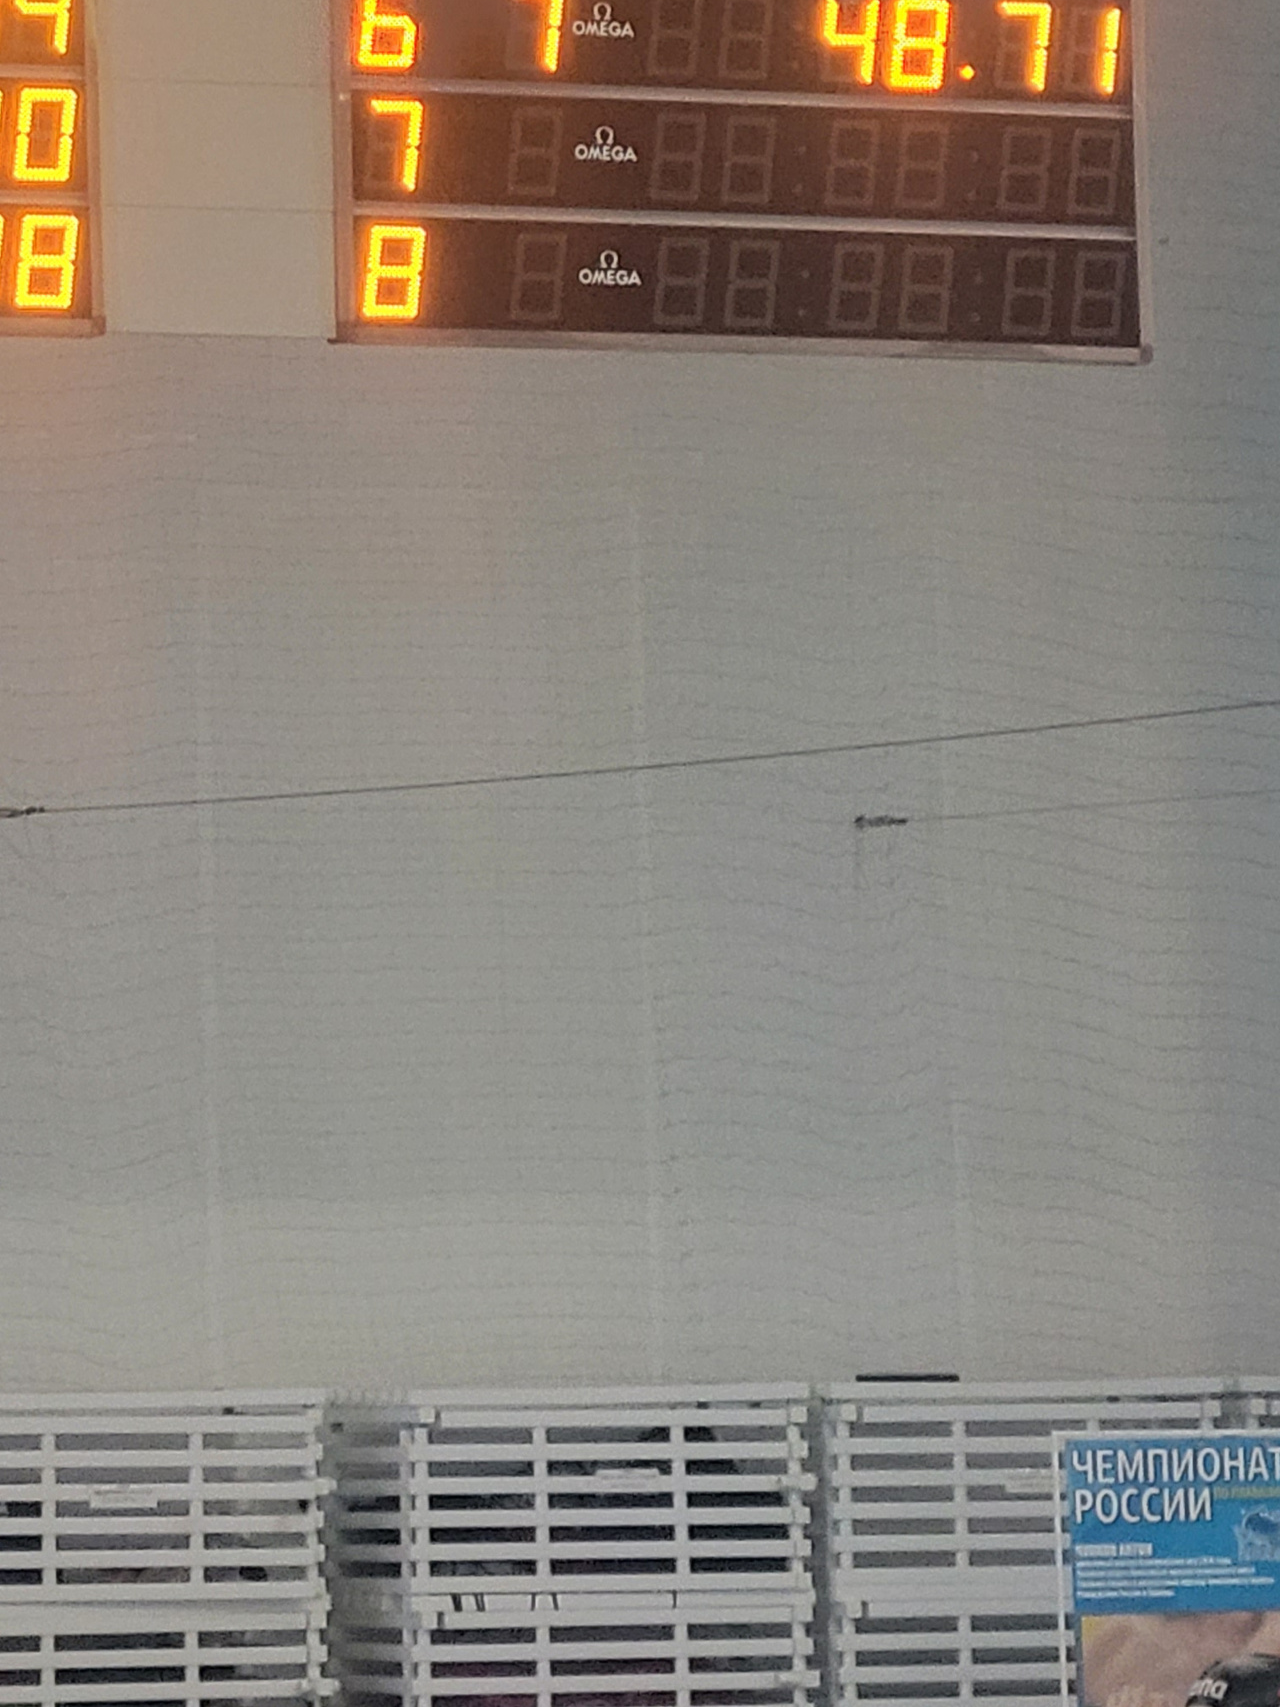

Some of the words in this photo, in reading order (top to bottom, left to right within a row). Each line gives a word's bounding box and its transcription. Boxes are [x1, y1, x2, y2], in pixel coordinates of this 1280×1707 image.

[572, 20, 634, 39] OMEGA
[368, 94, 427, 193] 7
[574, 144, 637, 162] OMEGA
[357, 220, 427, 323] 8
[578, 267, 642, 286] OMEGA
[1075, 1487, 1212, 1524] РОССИИ
